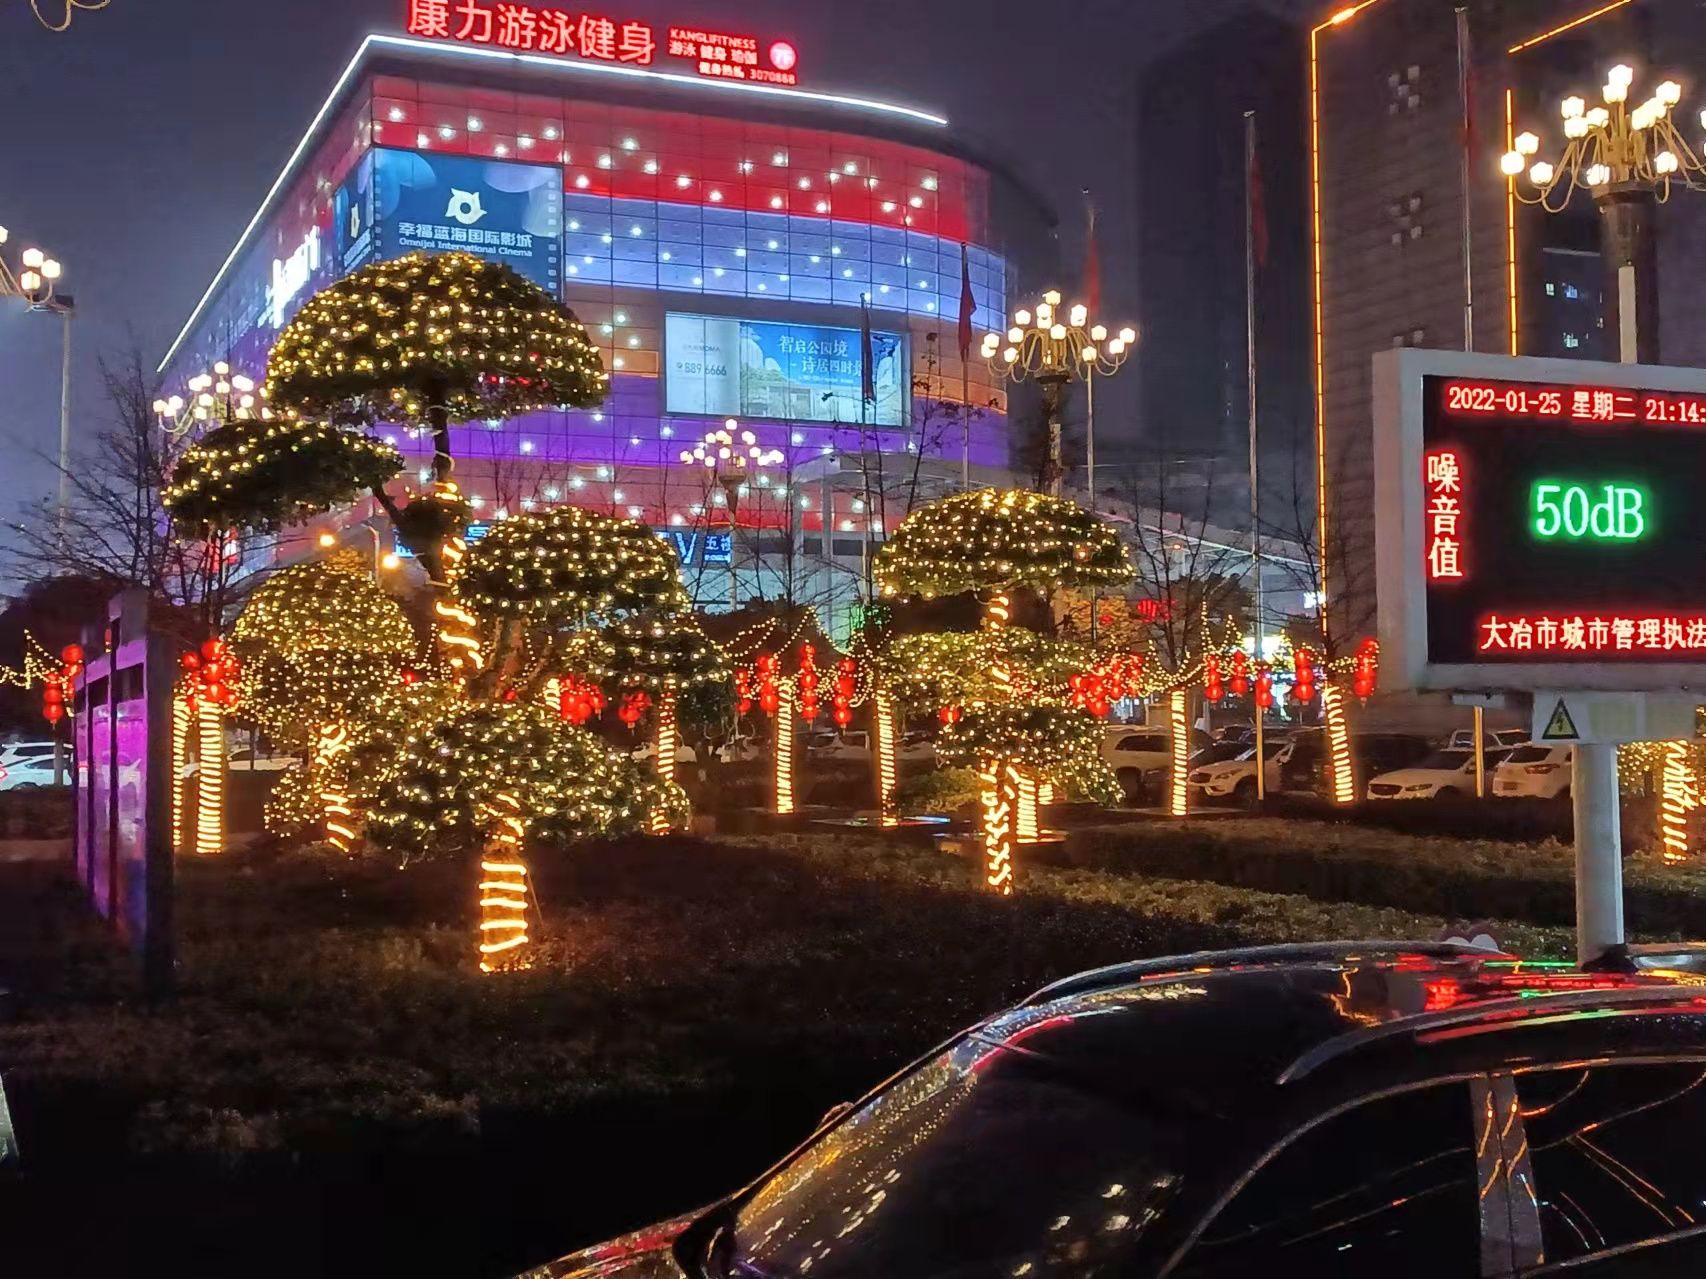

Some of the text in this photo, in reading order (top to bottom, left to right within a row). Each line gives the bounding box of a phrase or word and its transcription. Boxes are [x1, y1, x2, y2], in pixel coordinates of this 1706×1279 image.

[408, 0, 656, 63] 康力游泳健身
[398, 222, 533, 247] 幸福蓝海国际影城
[438, 241, 497, 254] International
[499, 247, 533, 257] Cinema
[1449, 386, 1706, 423] 2022-01-25 星期二 21:14:
[1427, 453, 1463, 578] 噪音值
[1535, 484, 1645, 539] 50dB
[1480, 615, 1706, 651] 大冶市城市管理执法
